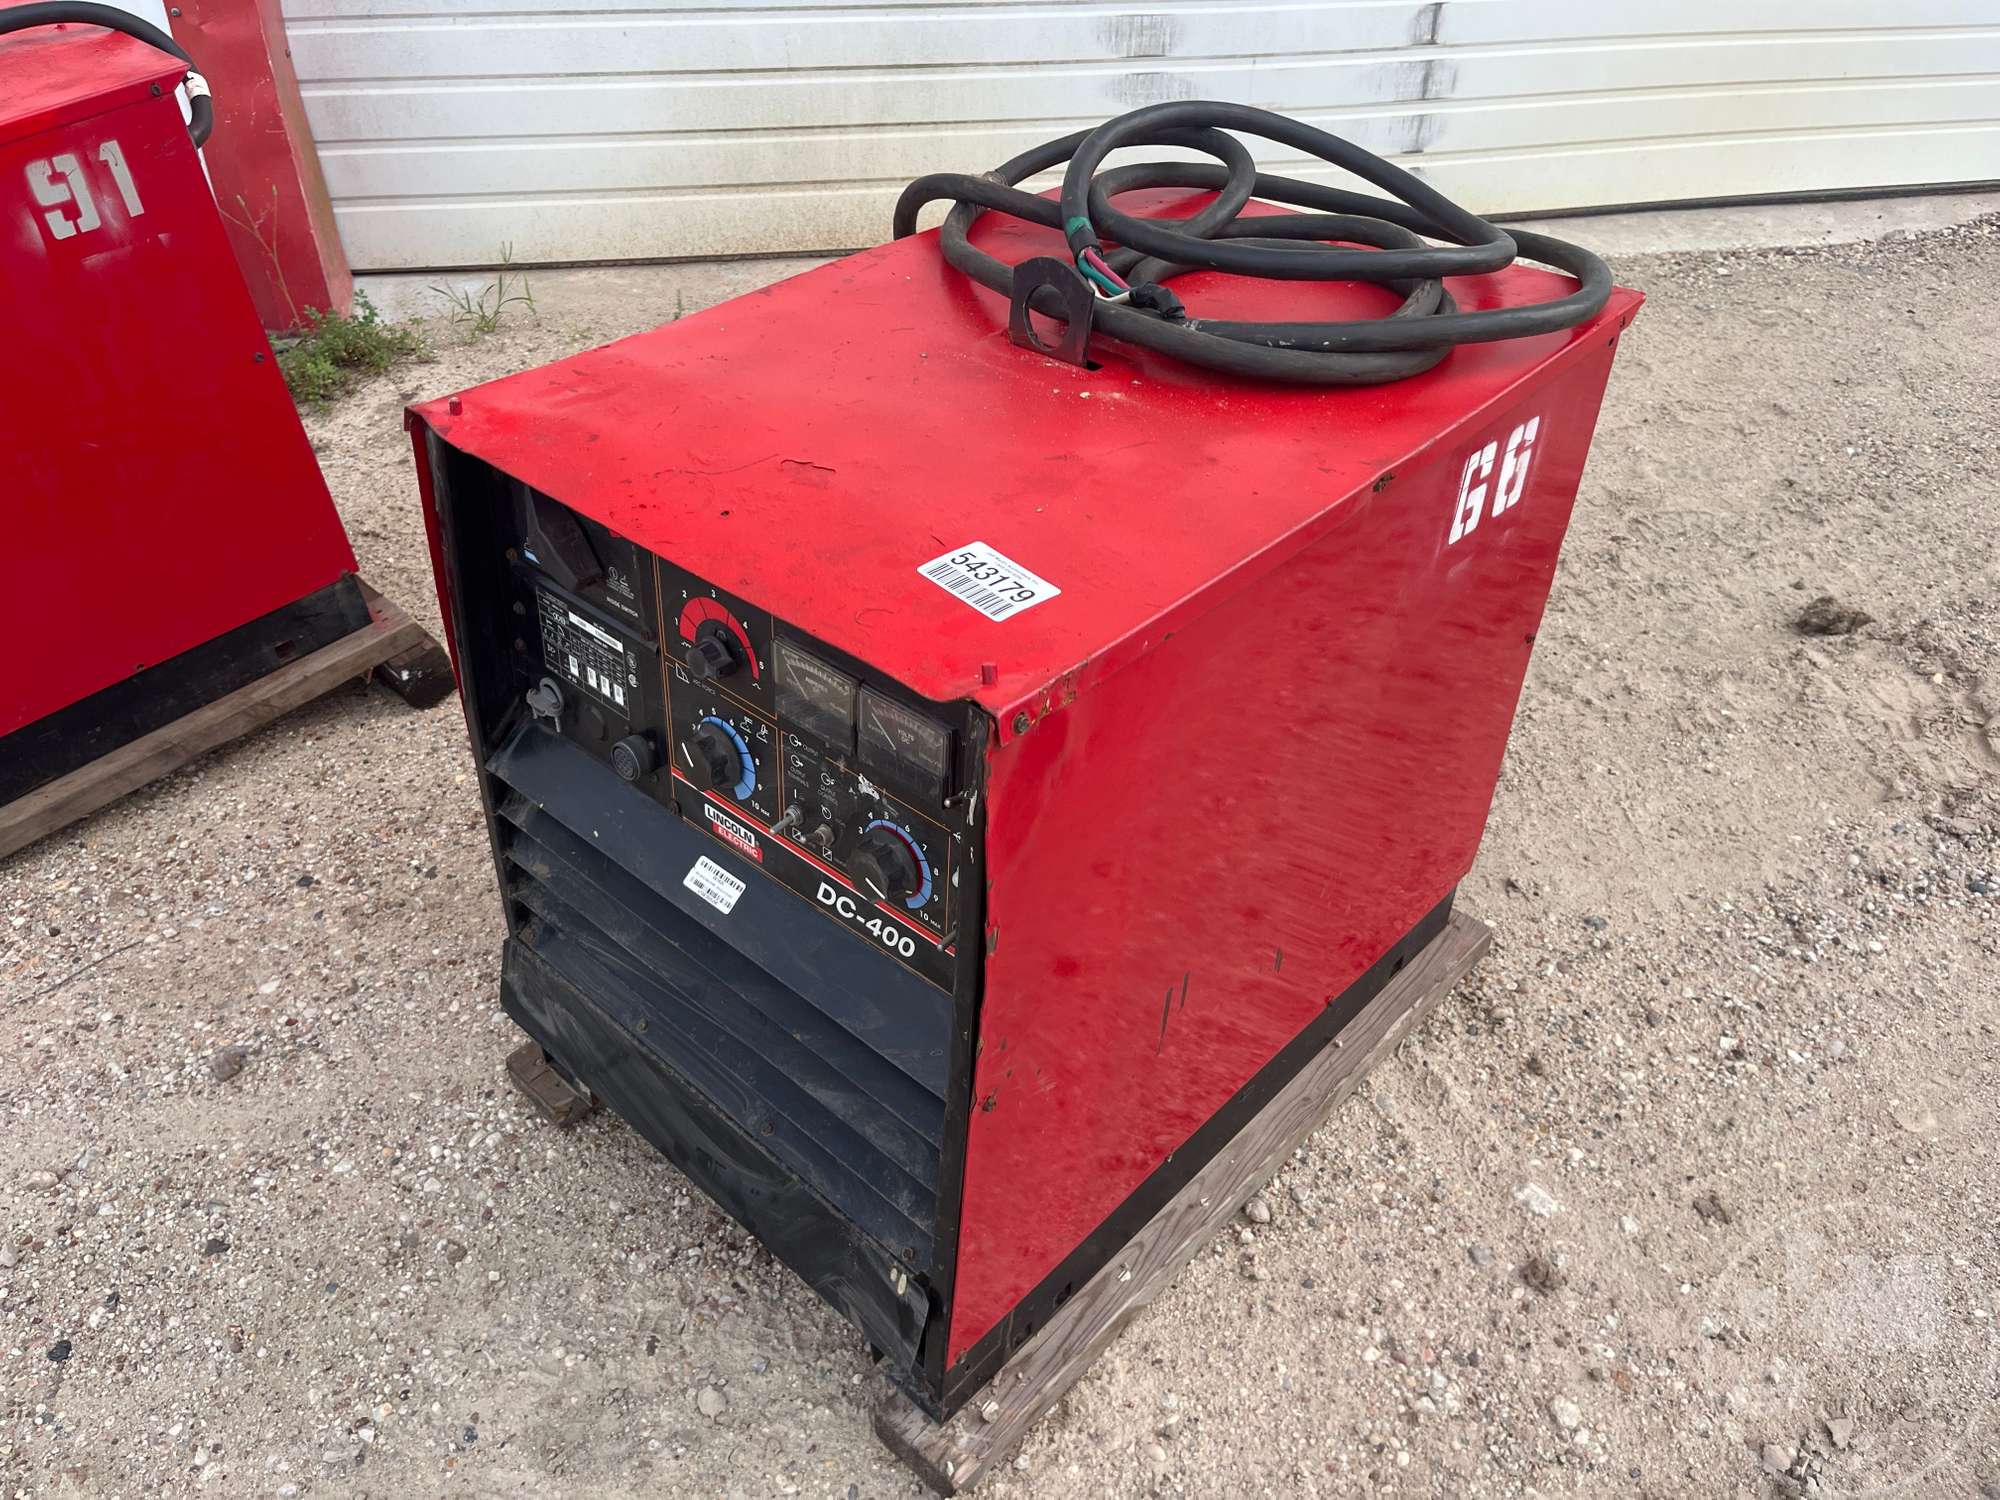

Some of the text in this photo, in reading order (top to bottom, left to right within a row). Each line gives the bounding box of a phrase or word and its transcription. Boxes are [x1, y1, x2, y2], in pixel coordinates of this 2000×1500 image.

[24, 138, 145, 241] 91
[1448, 415, 1540, 545] 66
[951, 552, 1036, 603] 543179
[682, 590, 688, 599] 2
[711, 589, 717, 599] 3
[674, 616, 680, 627] 1
[743, 620, 749, 630] 4
[759, 661, 765, 670] 5
[699, 708, 704, 717] 4
[711, 707, 717, 716] 5
[730, 718, 735, 727] 6
[744, 736, 750, 744] 7
[757, 783, 763, 791] 9
[750, 799, 760, 811] 10
[868, 811, 874, 820] 4
[884, 811, 889, 820] 5
[707, 809, 753, 843] LINCOLN
[858, 826, 863, 834] 3
[905, 824, 910, 834] 6
[718, 826, 759, 859] ELECTRIC
[922, 844, 928, 852] 7
[934, 867, 939, 876] 8
[933, 894, 939, 902] 9
[816, 881, 916, 958] DC-400
[919, 909, 930, 922] 10
